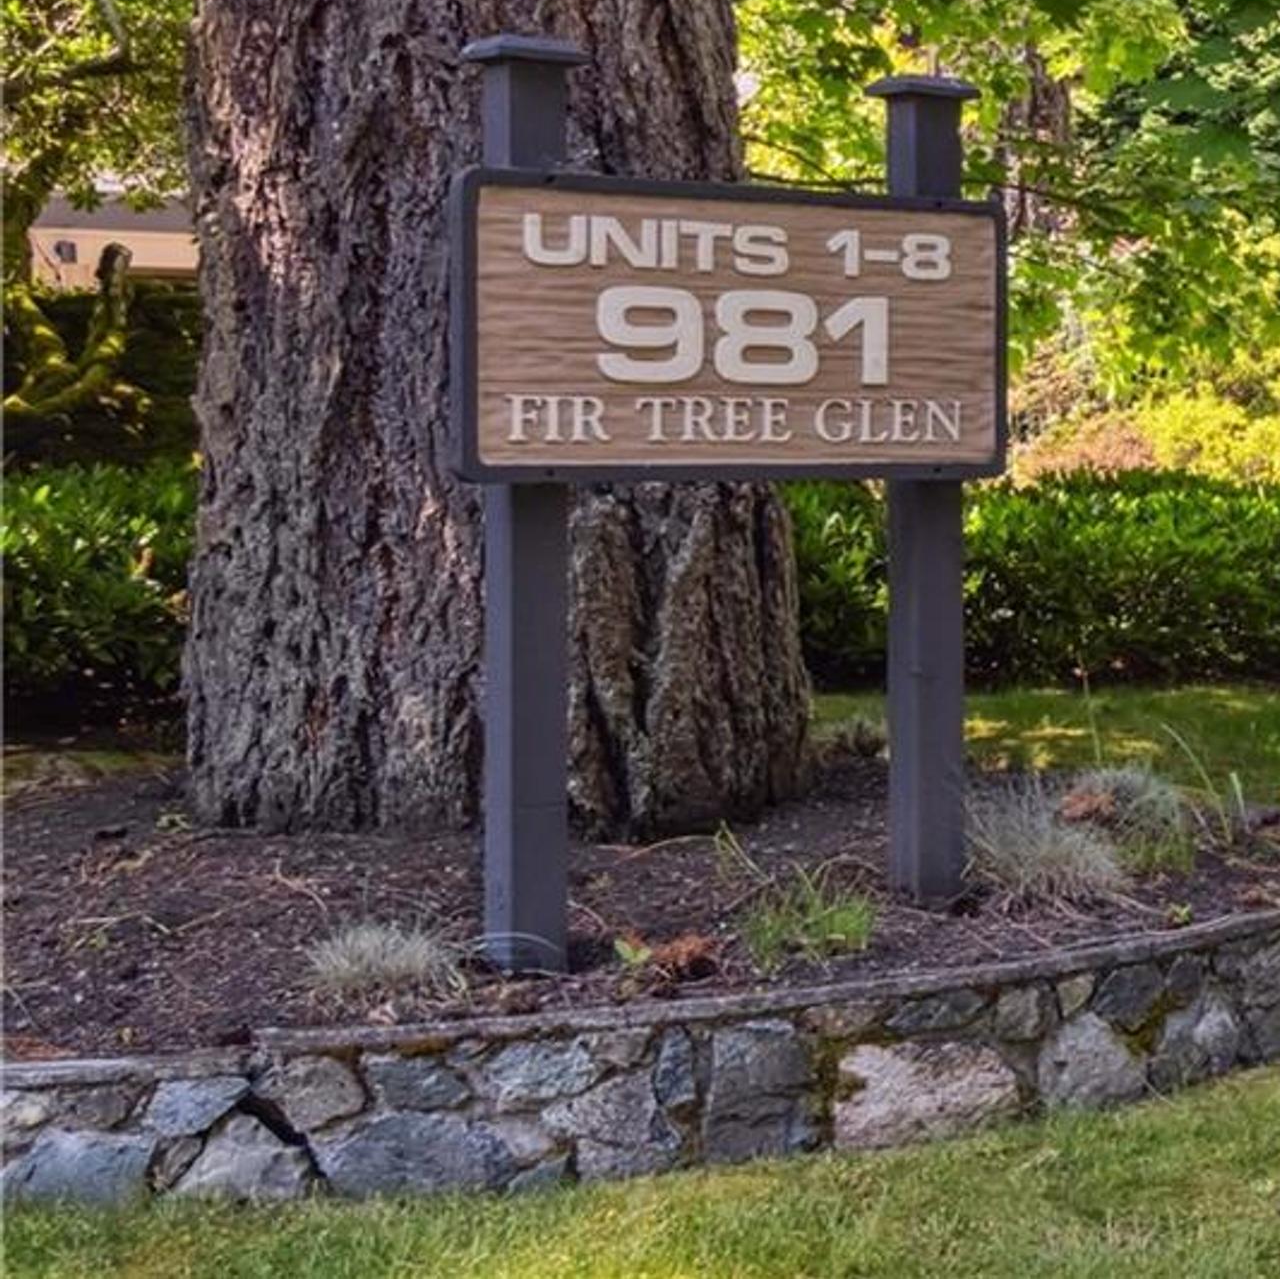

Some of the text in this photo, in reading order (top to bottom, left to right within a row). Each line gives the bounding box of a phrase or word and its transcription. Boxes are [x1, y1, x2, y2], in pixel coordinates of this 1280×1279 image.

[522, 213, 953, 281] UNITS 1-8
[596, 285, 891, 386] 981
[505, 394, 962, 443] FIR TREE GLEN
